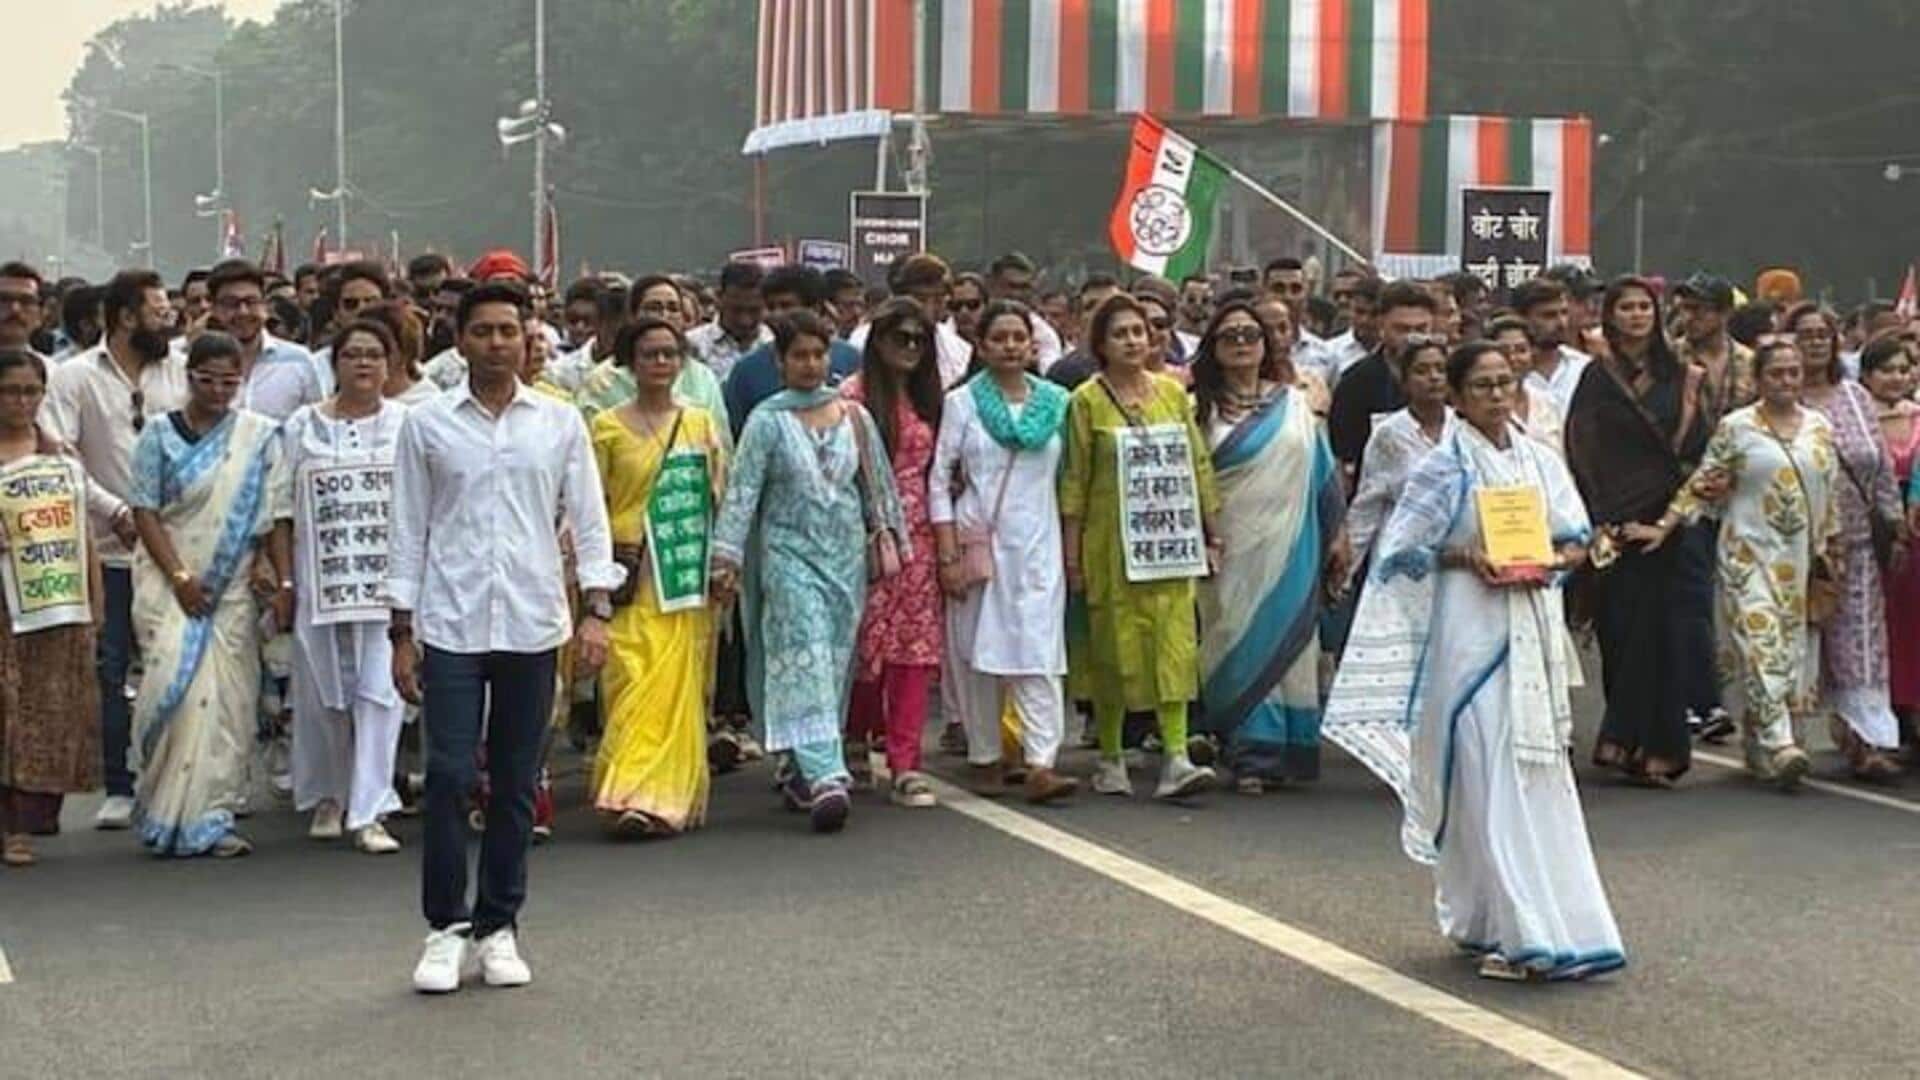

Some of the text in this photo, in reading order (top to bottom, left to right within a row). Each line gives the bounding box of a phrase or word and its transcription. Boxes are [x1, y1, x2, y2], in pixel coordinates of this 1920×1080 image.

[1471, 207, 1539, 240] वोट चोर
[316, 475, 353, 495] ১০০
[18, 501, 72, 533] ভোট
